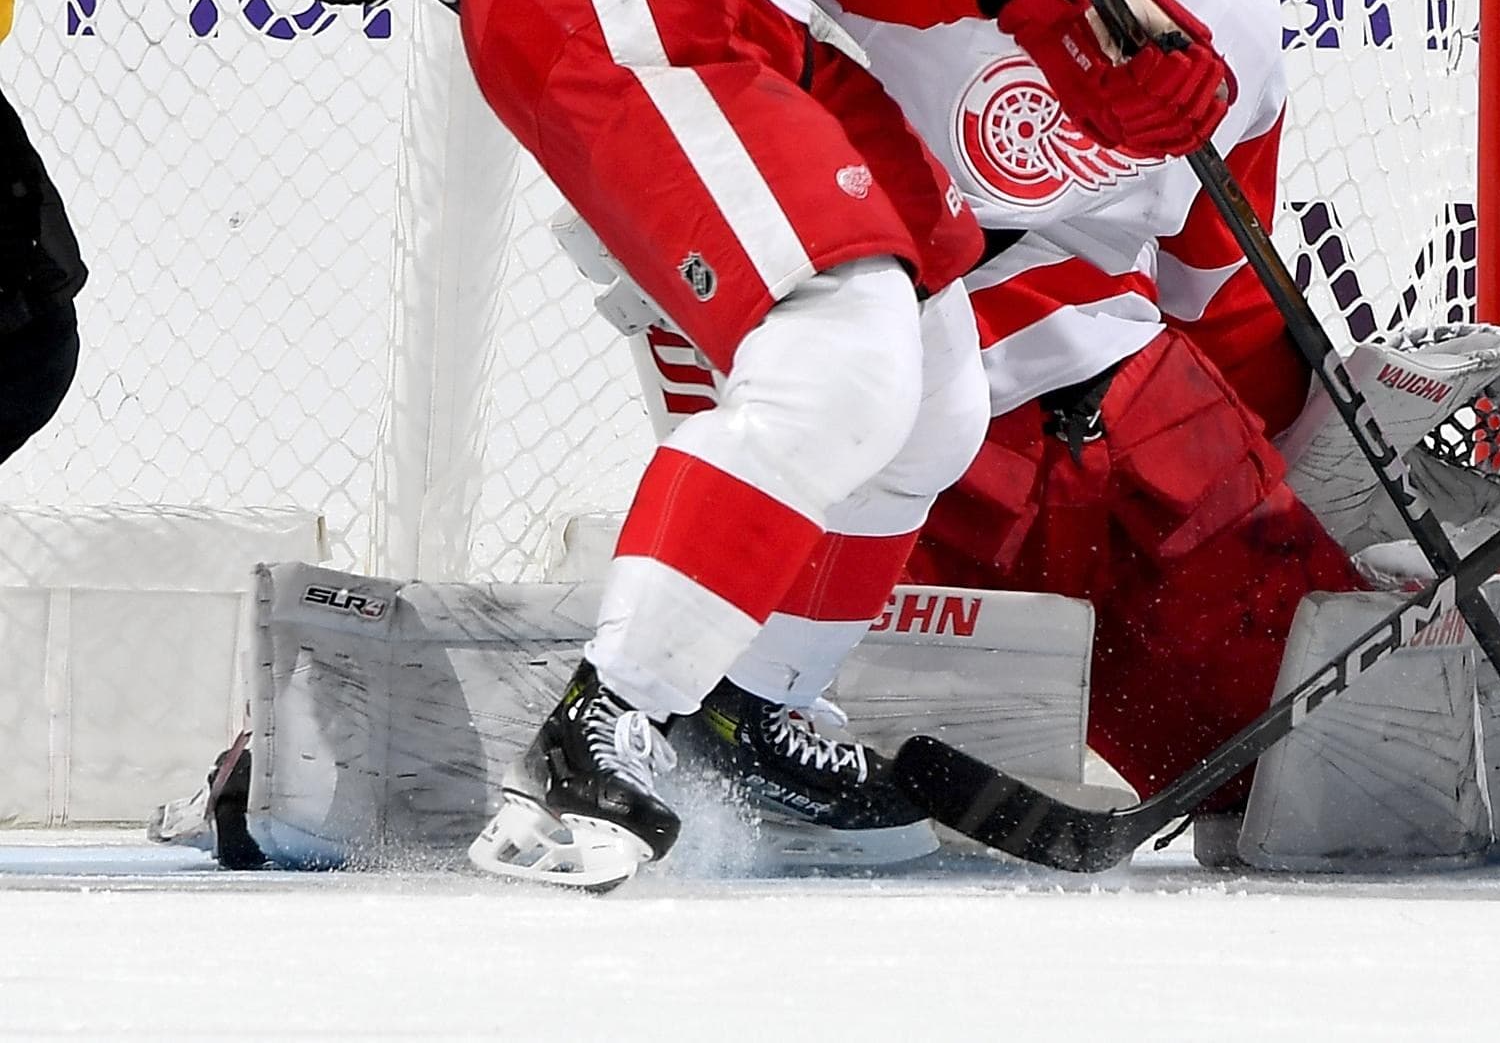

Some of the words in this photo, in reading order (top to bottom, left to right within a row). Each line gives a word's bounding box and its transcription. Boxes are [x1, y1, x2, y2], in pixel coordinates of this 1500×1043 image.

[1376, 362, 1453, 404] VAUGHN
[1323, 346, 1430, 522] CCM
[868, 593, 983, 637] GHN
[1291, 575, 1457, 731] CCM
